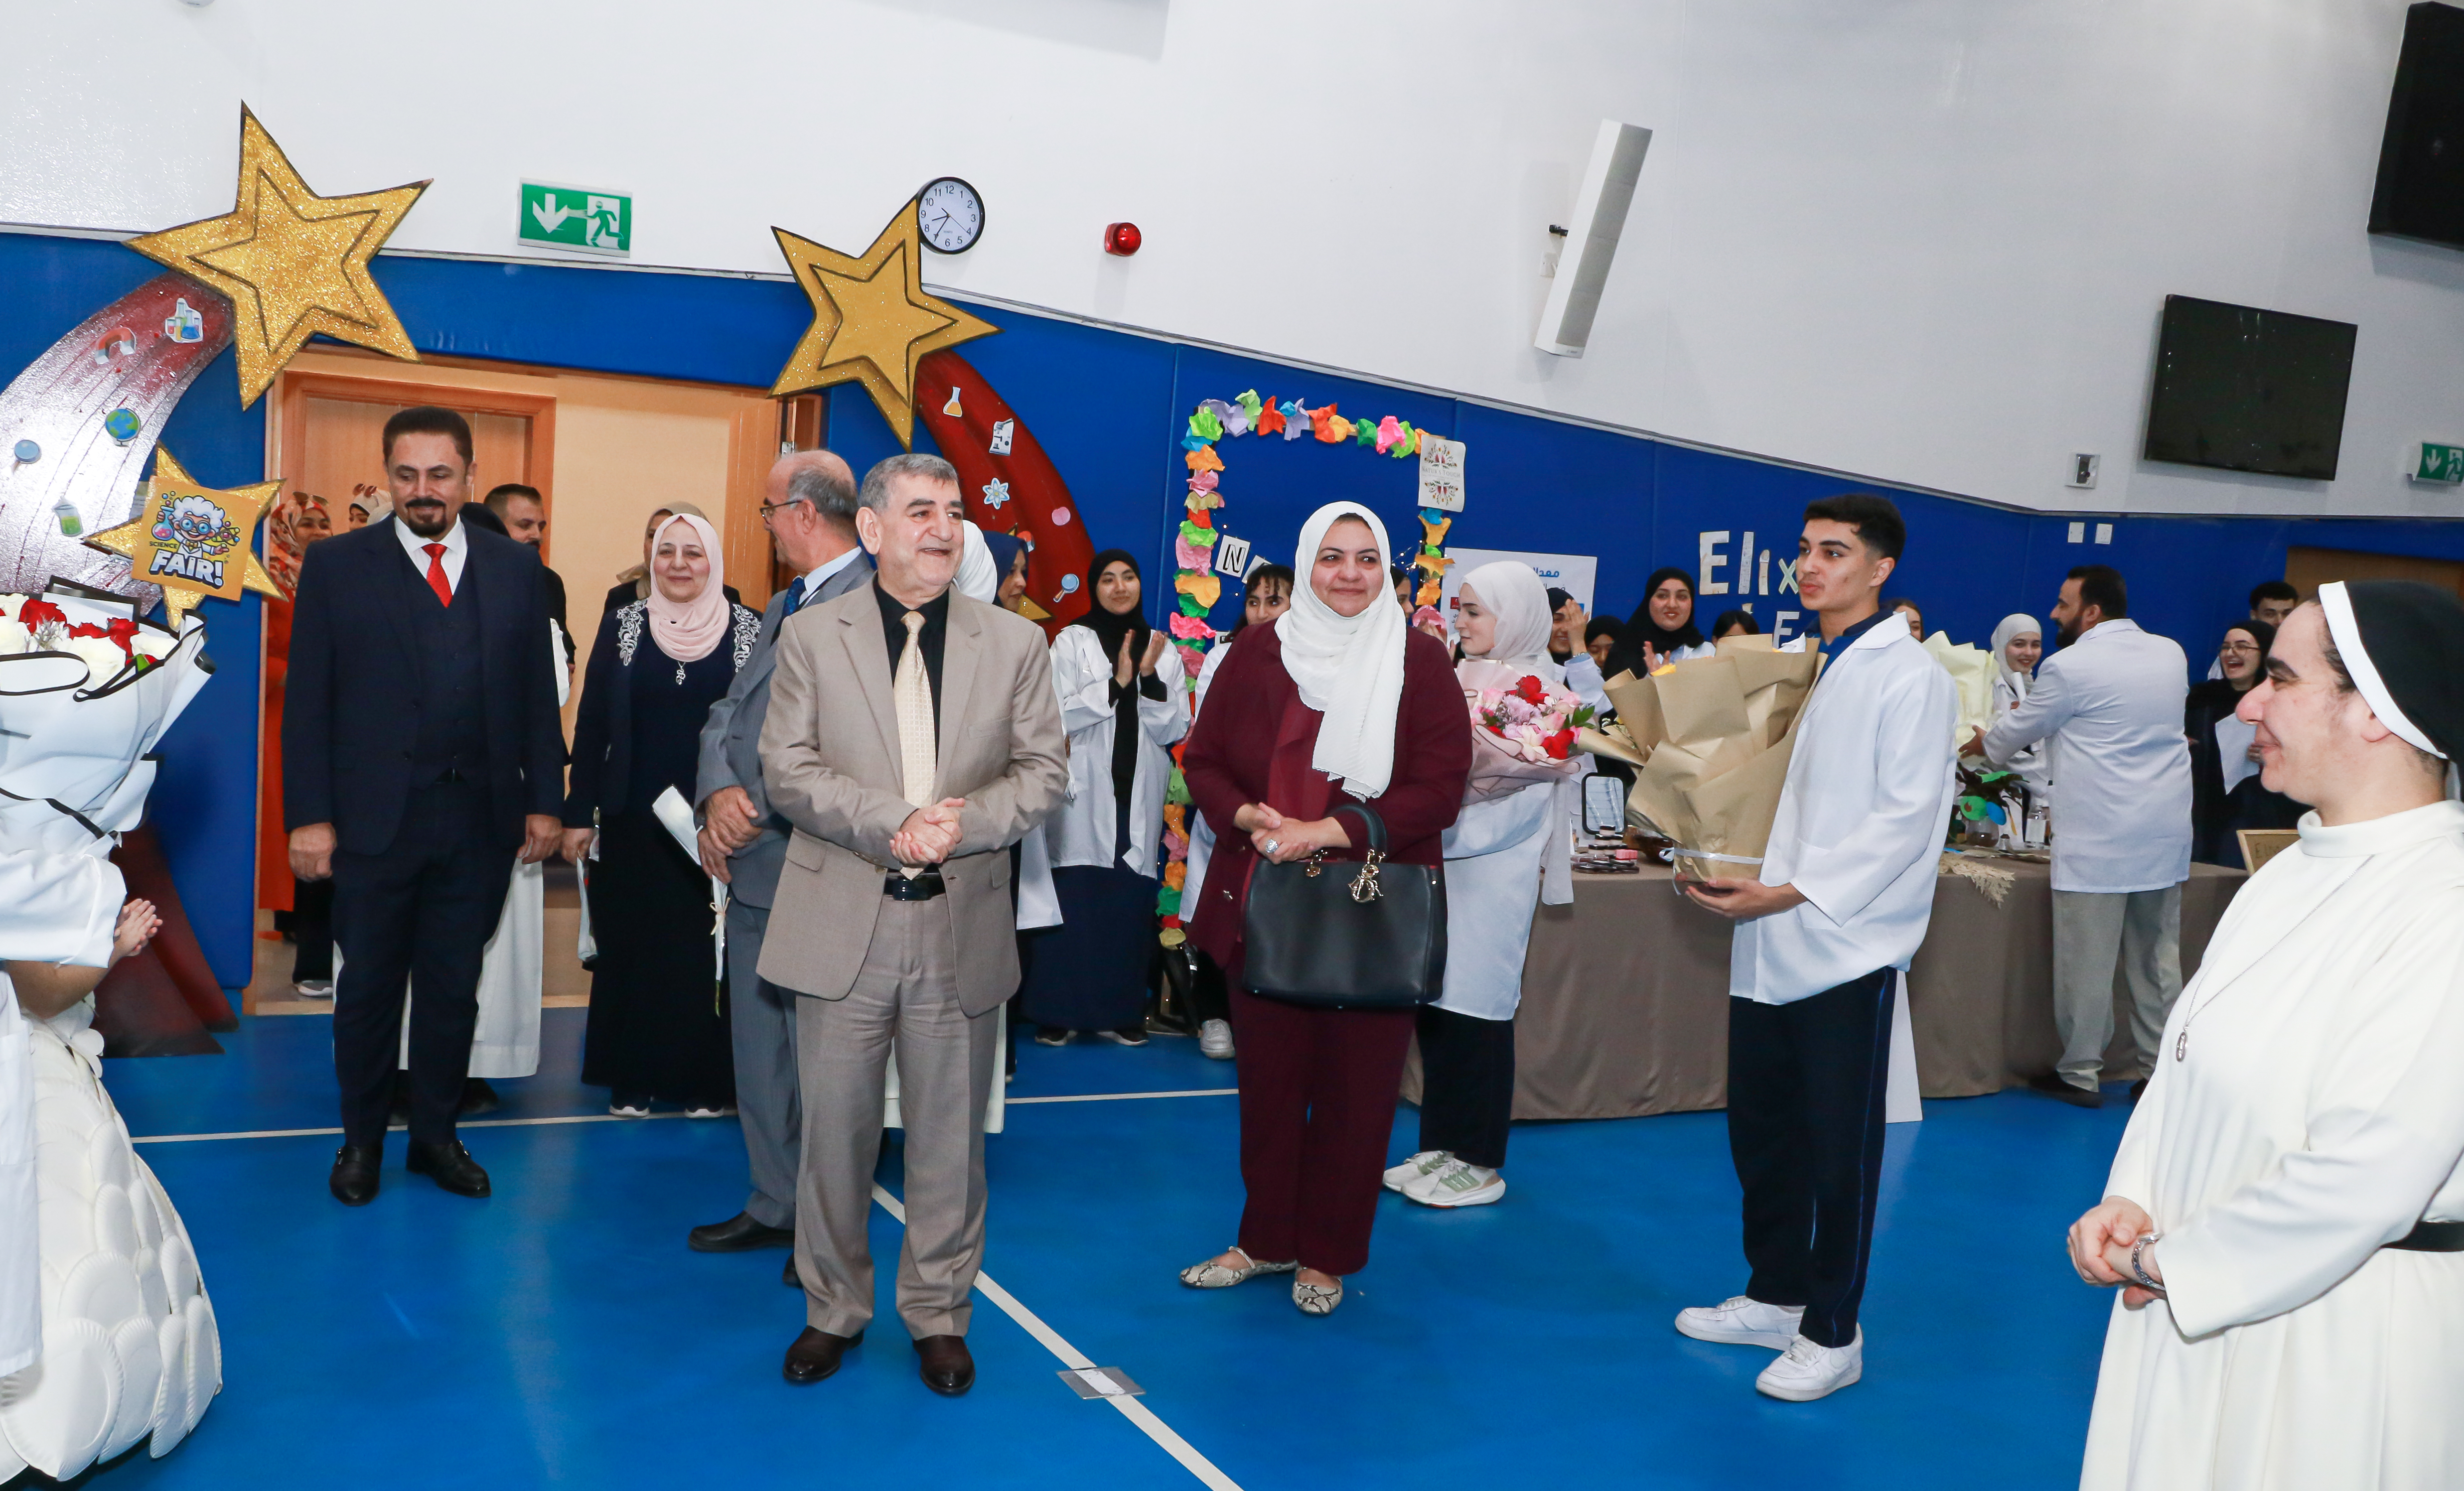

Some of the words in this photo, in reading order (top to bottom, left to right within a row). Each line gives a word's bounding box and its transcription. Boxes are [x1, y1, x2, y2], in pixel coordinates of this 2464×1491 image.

[946, 185, 954, 194] 12
[925, 198, 934, 206] 10
[967, 200, 972, 208] 2
[945, 238, 950, 247] 6
[1222, 544, 1246, 573] N
[149, 549, 223, 588] FAIR!
